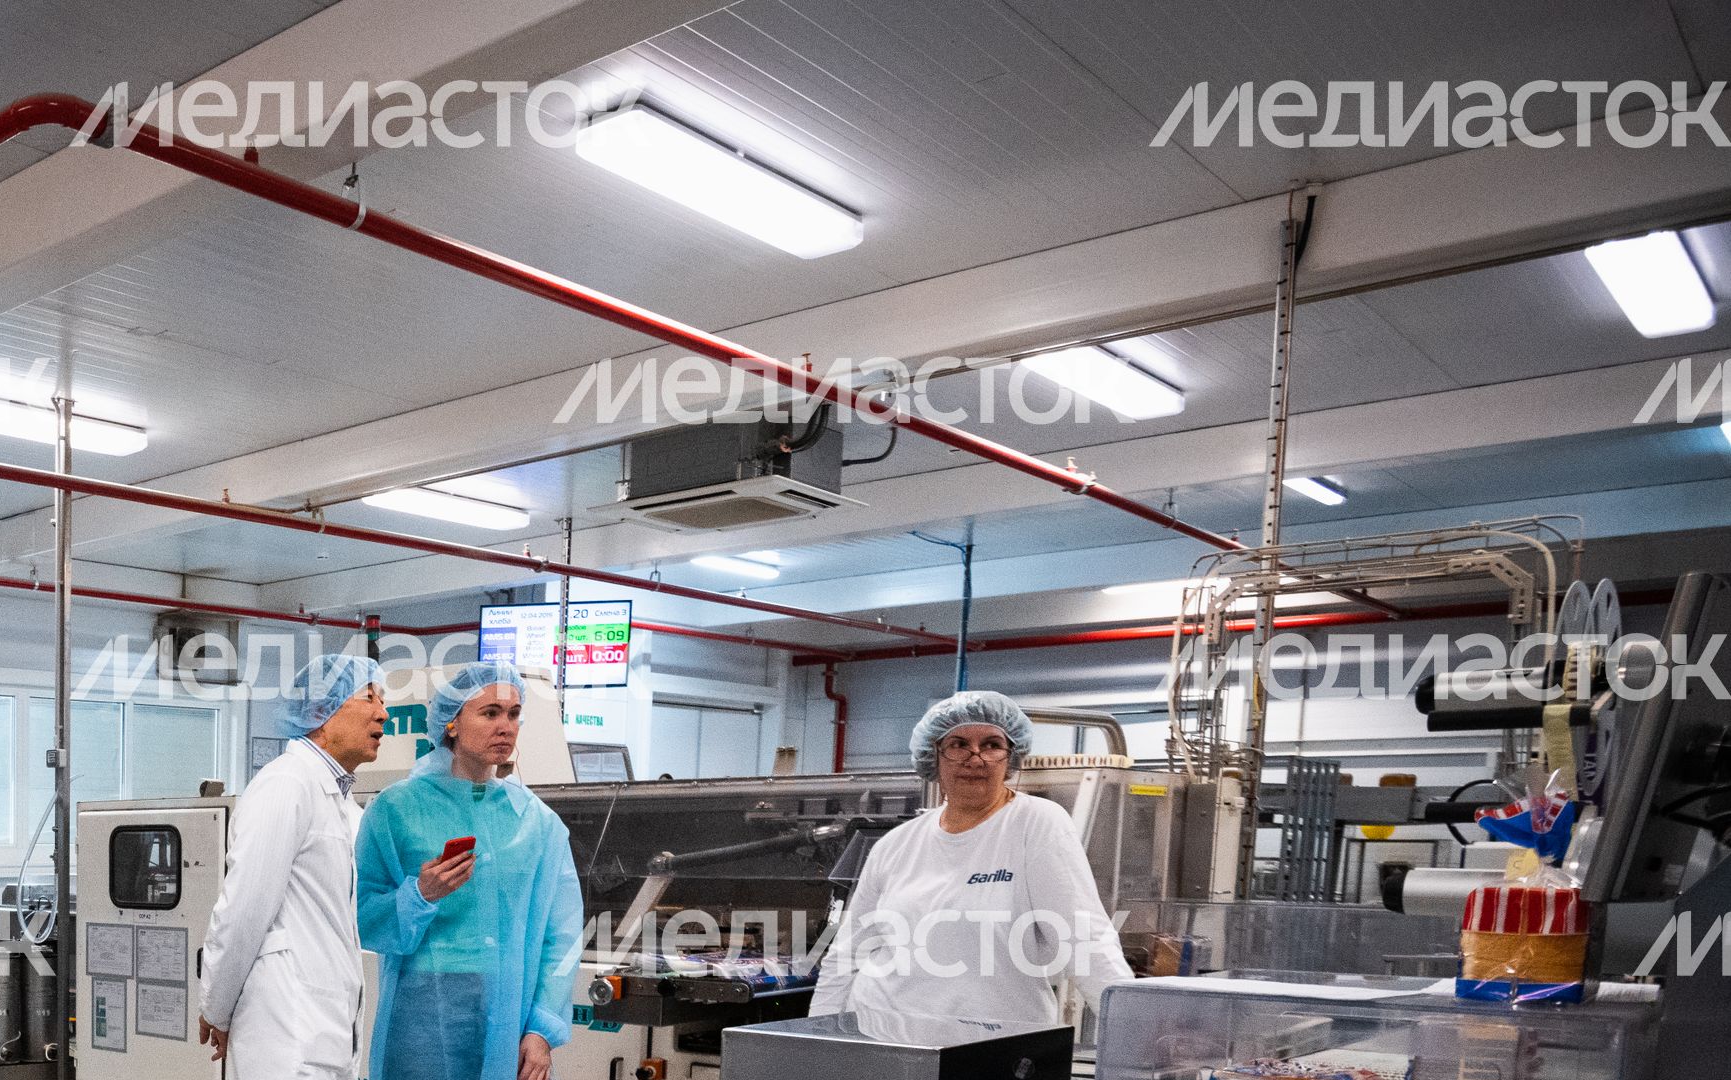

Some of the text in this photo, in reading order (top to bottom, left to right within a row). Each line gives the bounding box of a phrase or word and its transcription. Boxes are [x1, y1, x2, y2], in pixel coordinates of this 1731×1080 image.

[594, 630, 625, 642] 6:09
[591, 650, 624, 662] 0:00
[575, 715, 604, 727] КАЧЕСТВА
[967, 869, 1014, 884] Barilla
